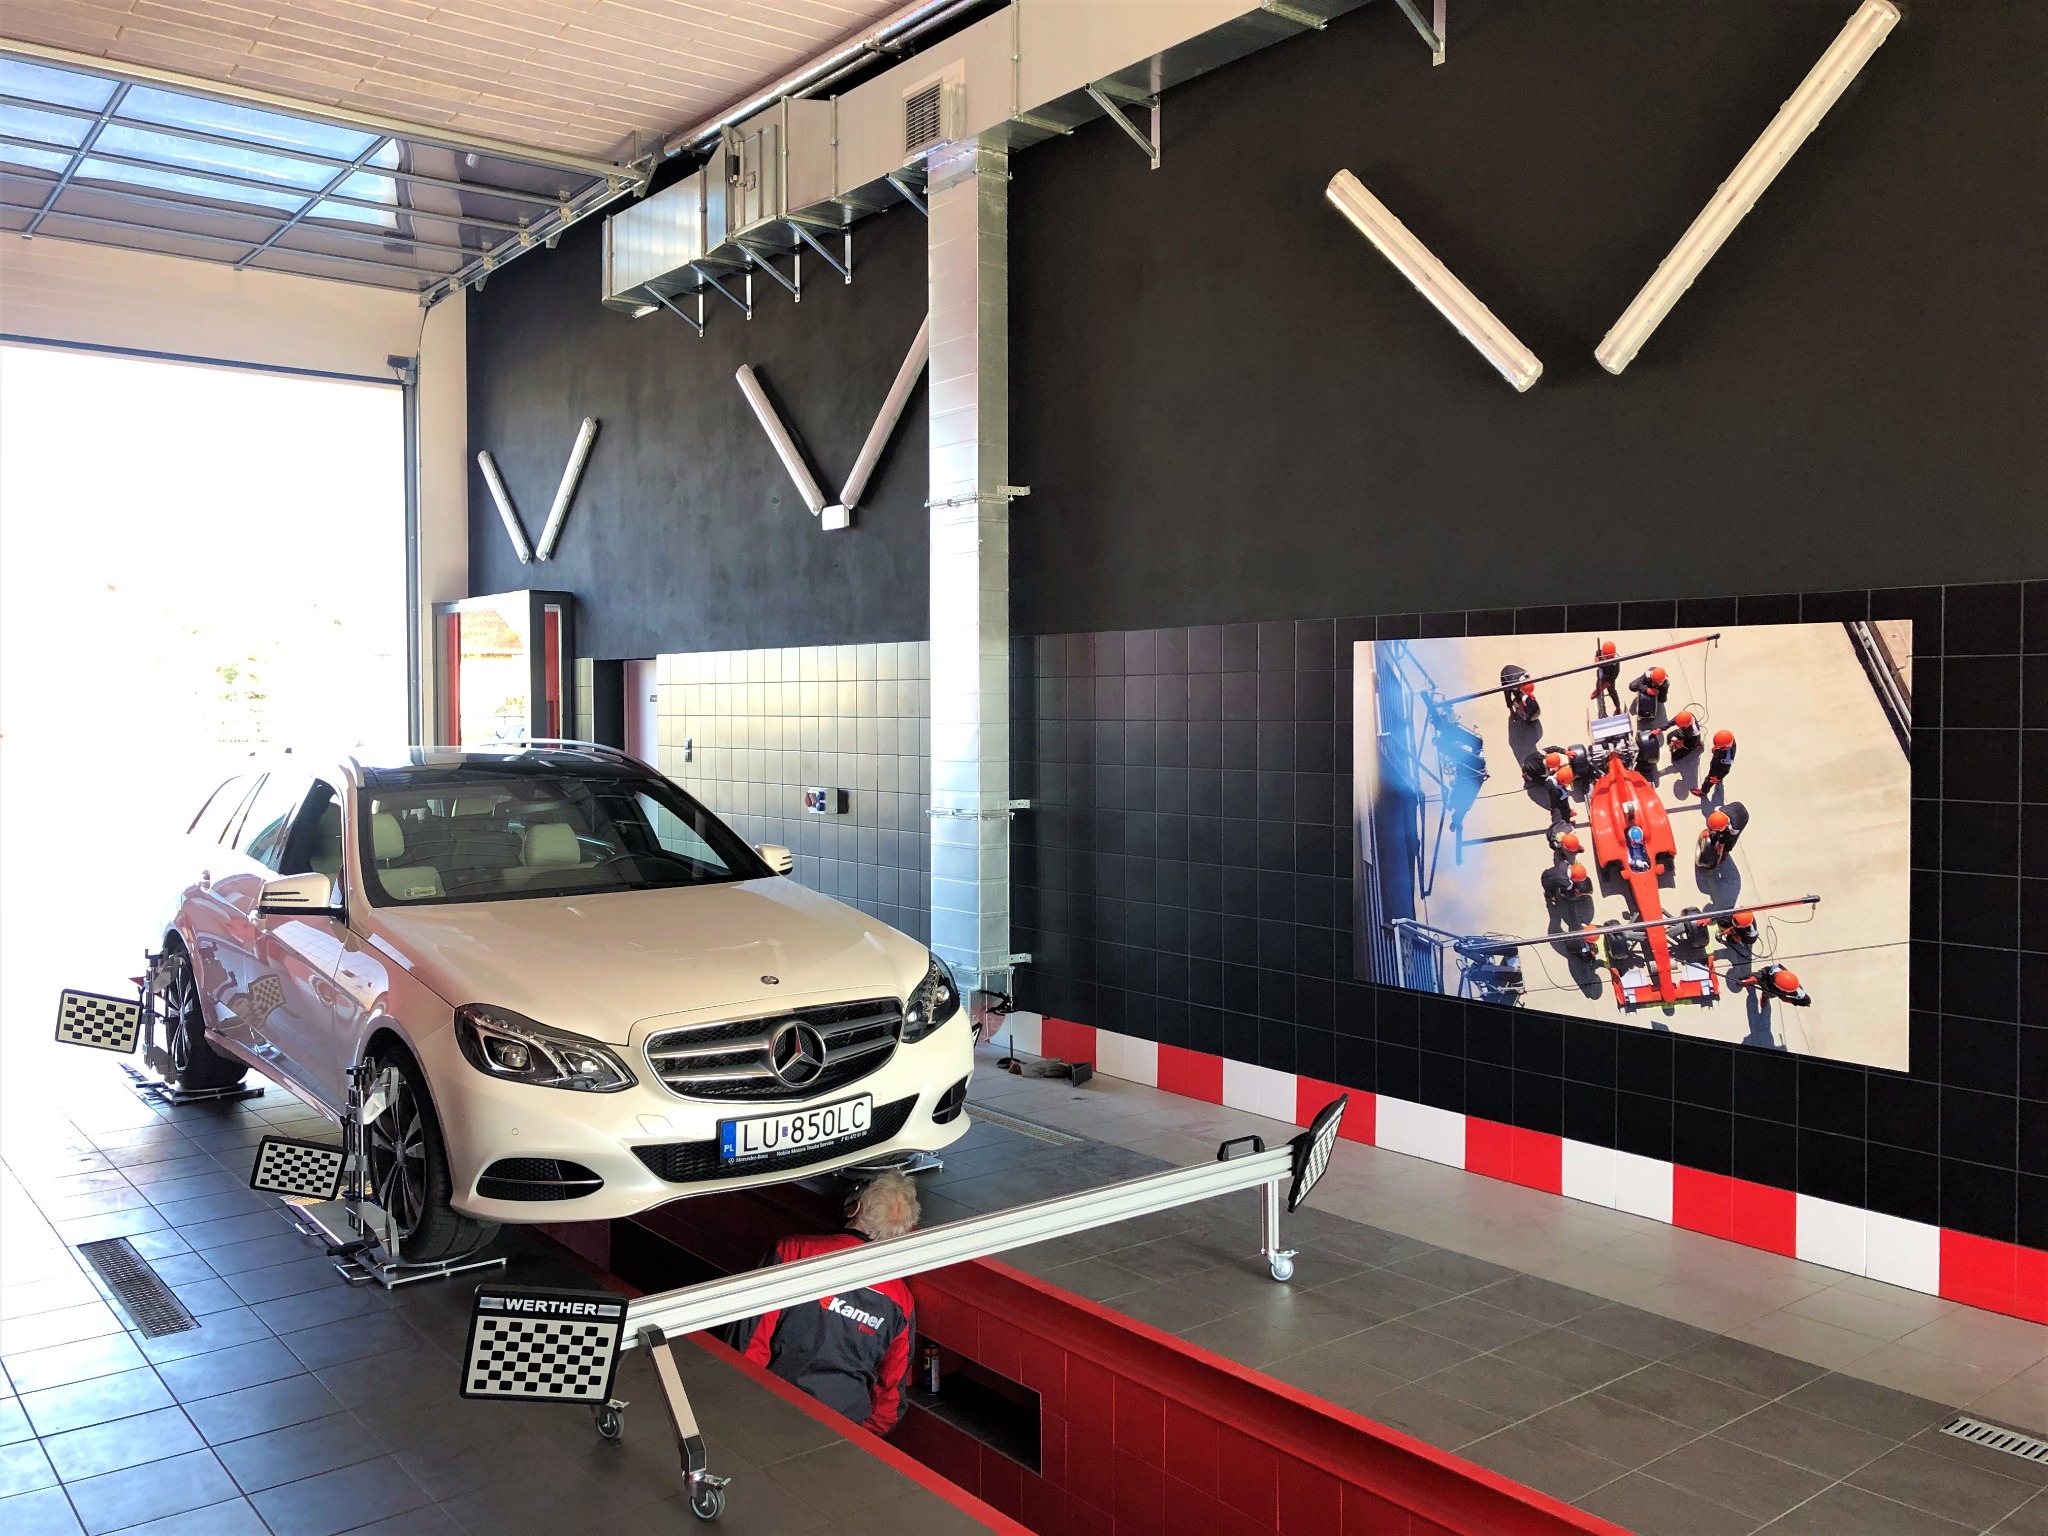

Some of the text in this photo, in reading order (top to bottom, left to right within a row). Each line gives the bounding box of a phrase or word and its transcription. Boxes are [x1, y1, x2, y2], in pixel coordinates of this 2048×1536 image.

[744, 1102, 864, 1152] LU 850LC
[724, 1144, 734, 1153] PL
[505, 1298, 597, 1316] WERTHER
[828, 1296, 885, 1330] Kamel
